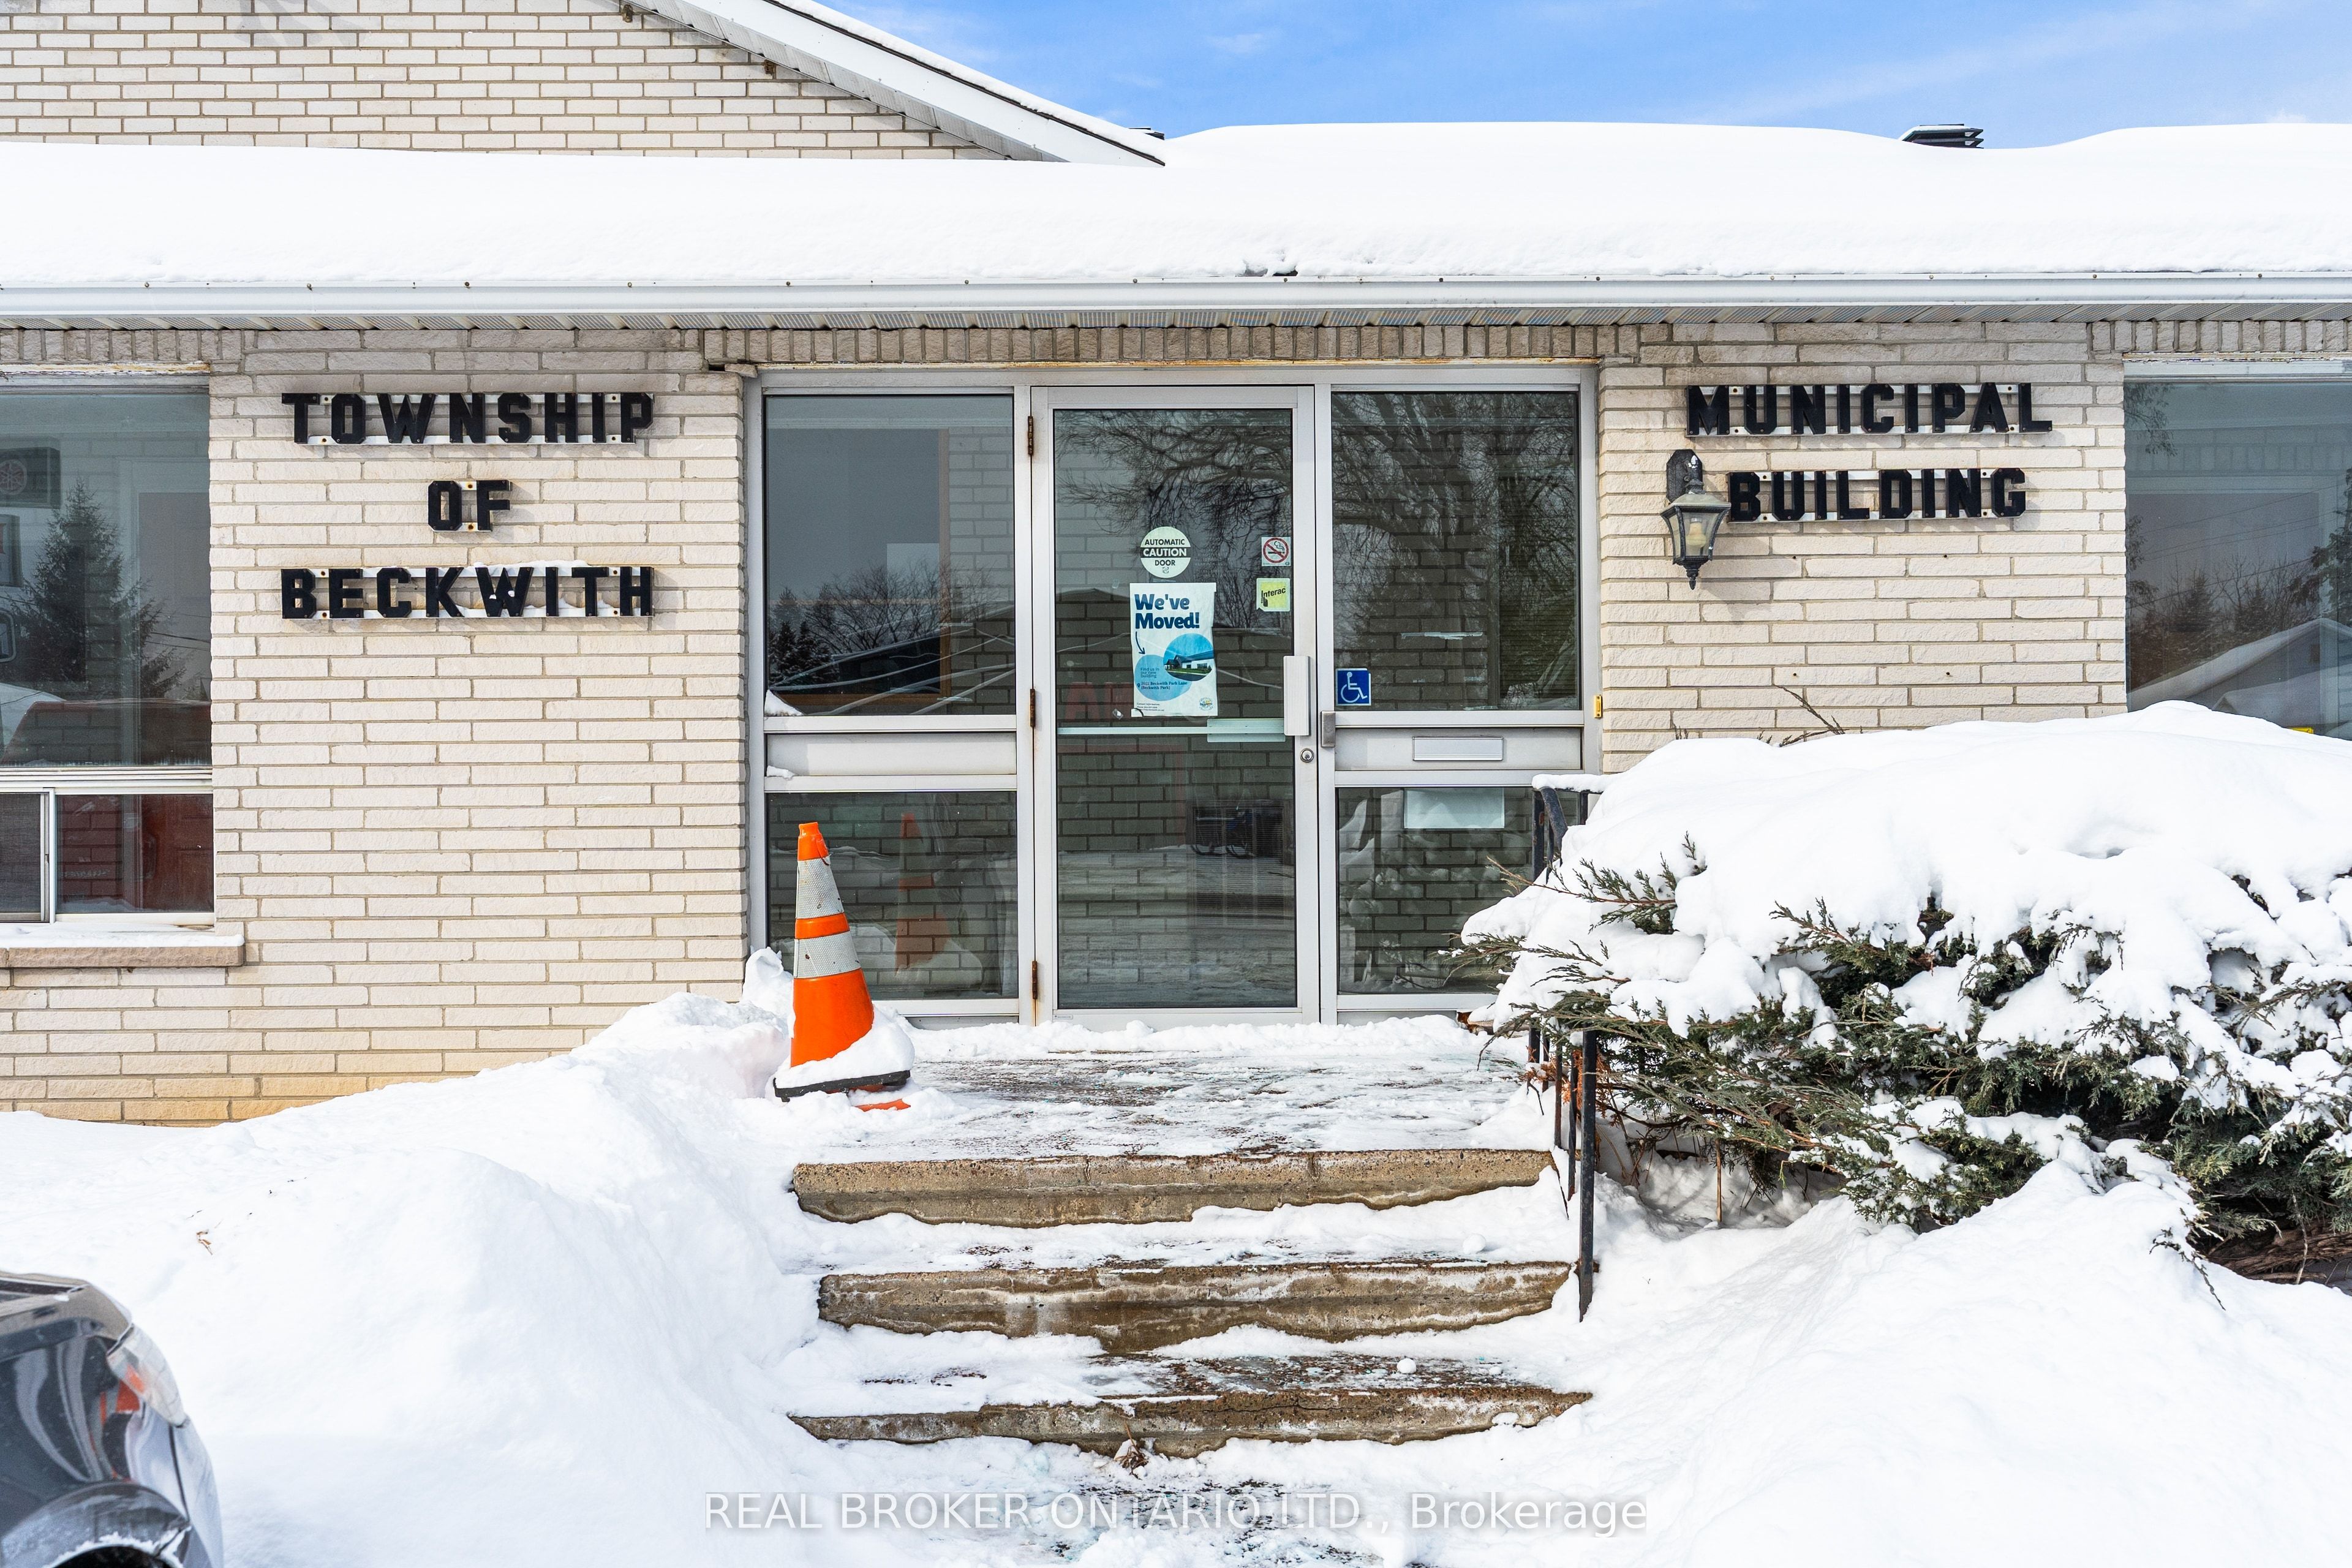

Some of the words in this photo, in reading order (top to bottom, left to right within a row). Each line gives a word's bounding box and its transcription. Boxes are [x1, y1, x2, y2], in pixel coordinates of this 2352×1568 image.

[282, 393, 654, 444] TOWNSHIP
[1686, 382, 2052, 435] MUNICIPAL
[428, 480, 512, 531] OF
[1727, 468, 2026, 522] BUILDING
[1143, 548, 1187, 557] CAUTION
[281, 567, 654, 619] BECKWITH
[1134, 594, 1190, 610] We've
[1261, 587, 1286, 598] Interac
[1135, 612, 1200, 629] Moved!
